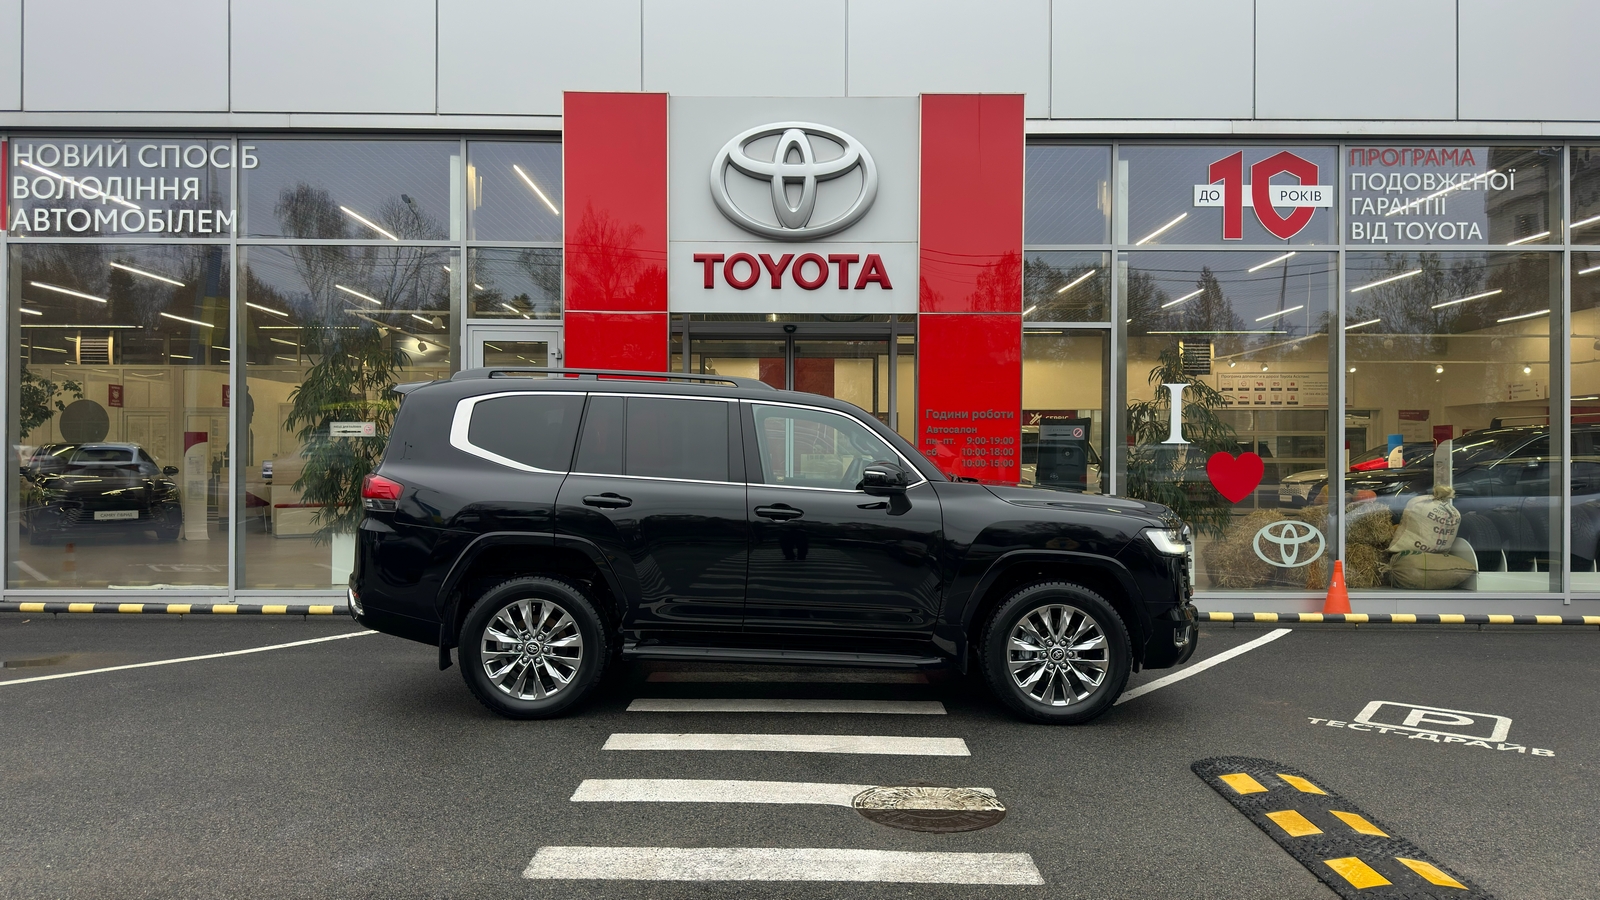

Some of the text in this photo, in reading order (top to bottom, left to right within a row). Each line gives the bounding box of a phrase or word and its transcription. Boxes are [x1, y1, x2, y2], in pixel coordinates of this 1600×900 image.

[14, 139, 259, 169] НОВИЙ СПОСІБ
[1350, 147, 1477, 167] ПРОГРАМА
[13, 175, 200, 205] ВОЛОДІННЯ
[1351, 168, 1516, 194] ПОДОВЖЕНОЇ
[1199, 150, 1323, 240] ДО 10 РОКІВ
[1351, 193, 1447, 216] ГАРАНТІЇ
[10, 208, 238, 233] АВТОМОБІЛЕМ
[1351, 221, 1483, 243] ВІД TOYOTA
[693, 252, 893, 291] TOYOTA
[925, 409, 1014, 422] Години роботи
[926, 425, 978, 434] Автосалон
[966, 436, 1014, 445] 9:00-19:00
[962, 447, 1014, 456] 10:00-18:00
[962, 459, 1014, 468] 10:00-15:00
[1433, 526, 1455, 536] CAFÉ
[1436, 538, 1447, 546] DE
[1402, 708, 1475, 728] P
[1307, 716, 1556, 758] ТЕСТ-ДРАЙВ
